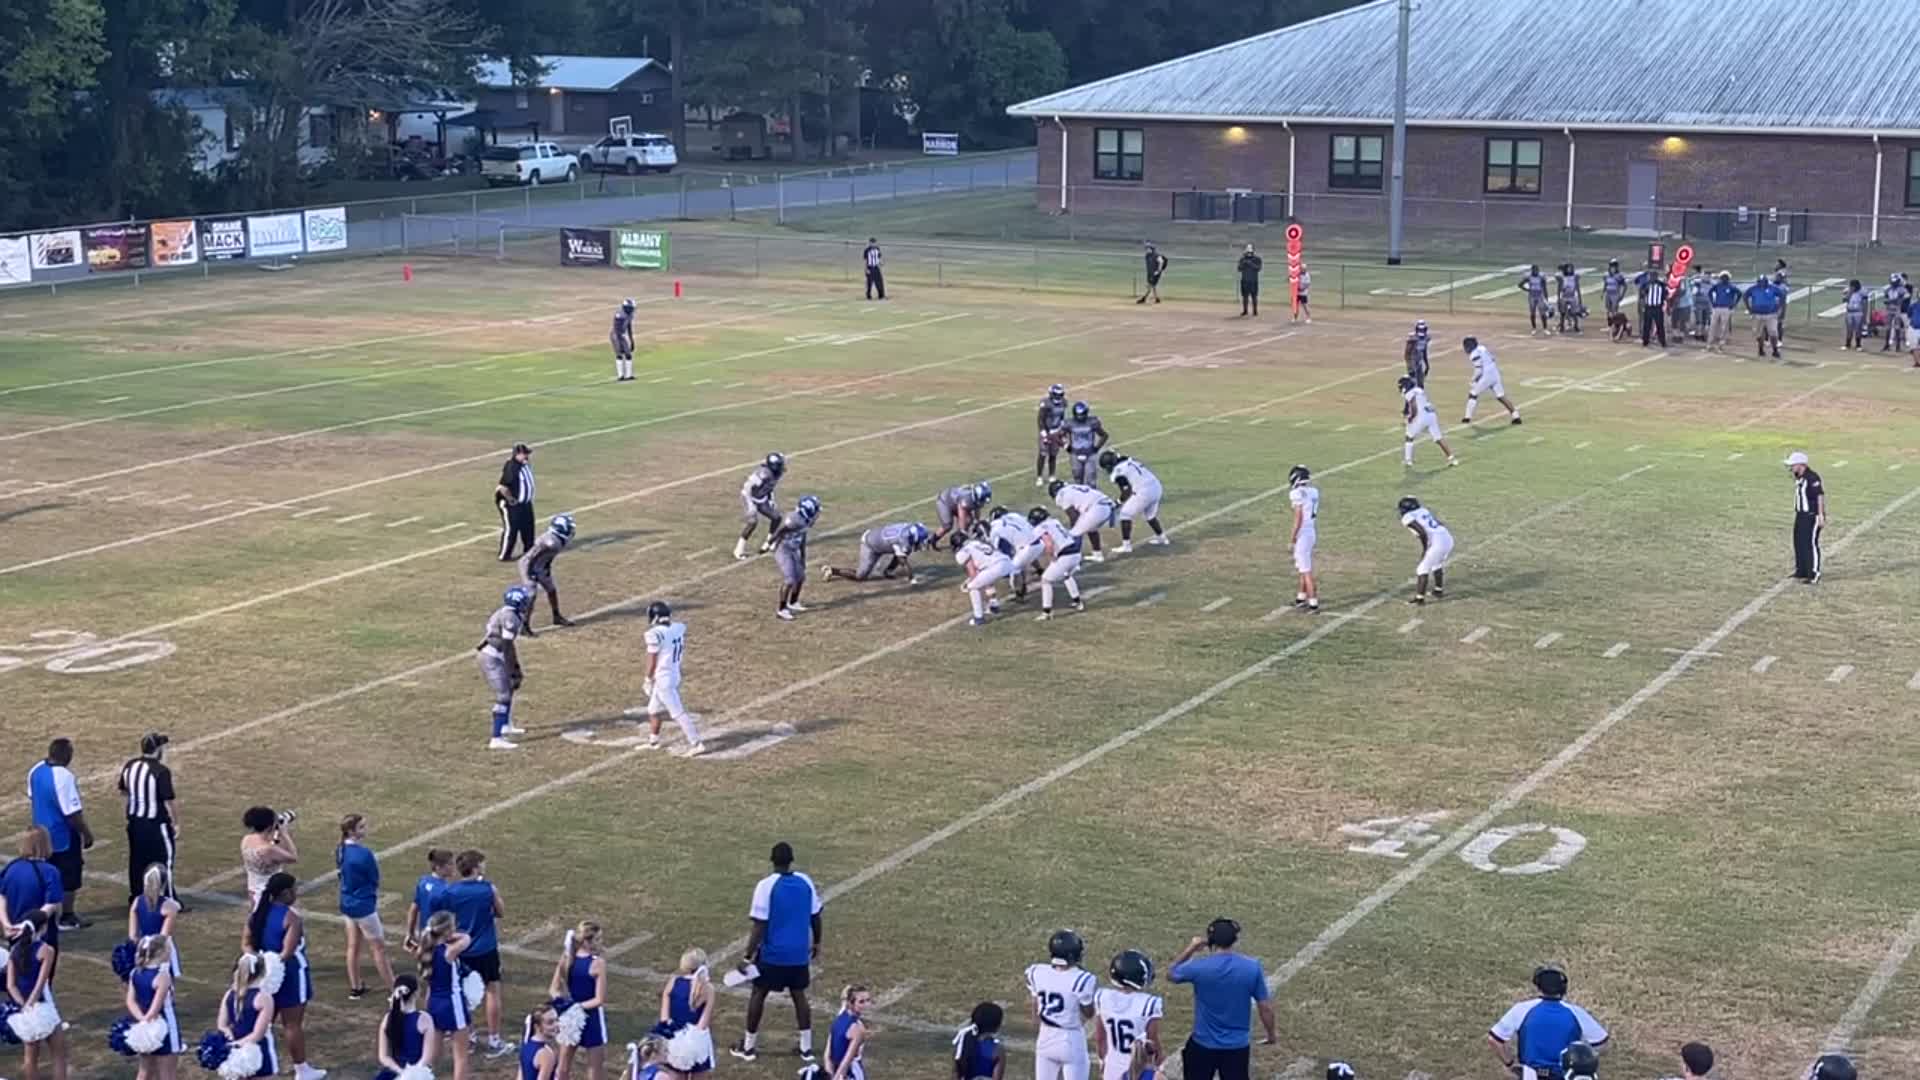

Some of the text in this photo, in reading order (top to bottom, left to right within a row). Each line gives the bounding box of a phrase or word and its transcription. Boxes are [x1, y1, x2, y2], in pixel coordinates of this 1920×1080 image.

[204, 233, 242, 247] MACK
[620, 232, 662, 249] ALBANY
[671, 635, 683, 664] 11
[1338, 808, 1588, 875] 40
[1106, 1018, 1135, 1055] 16
